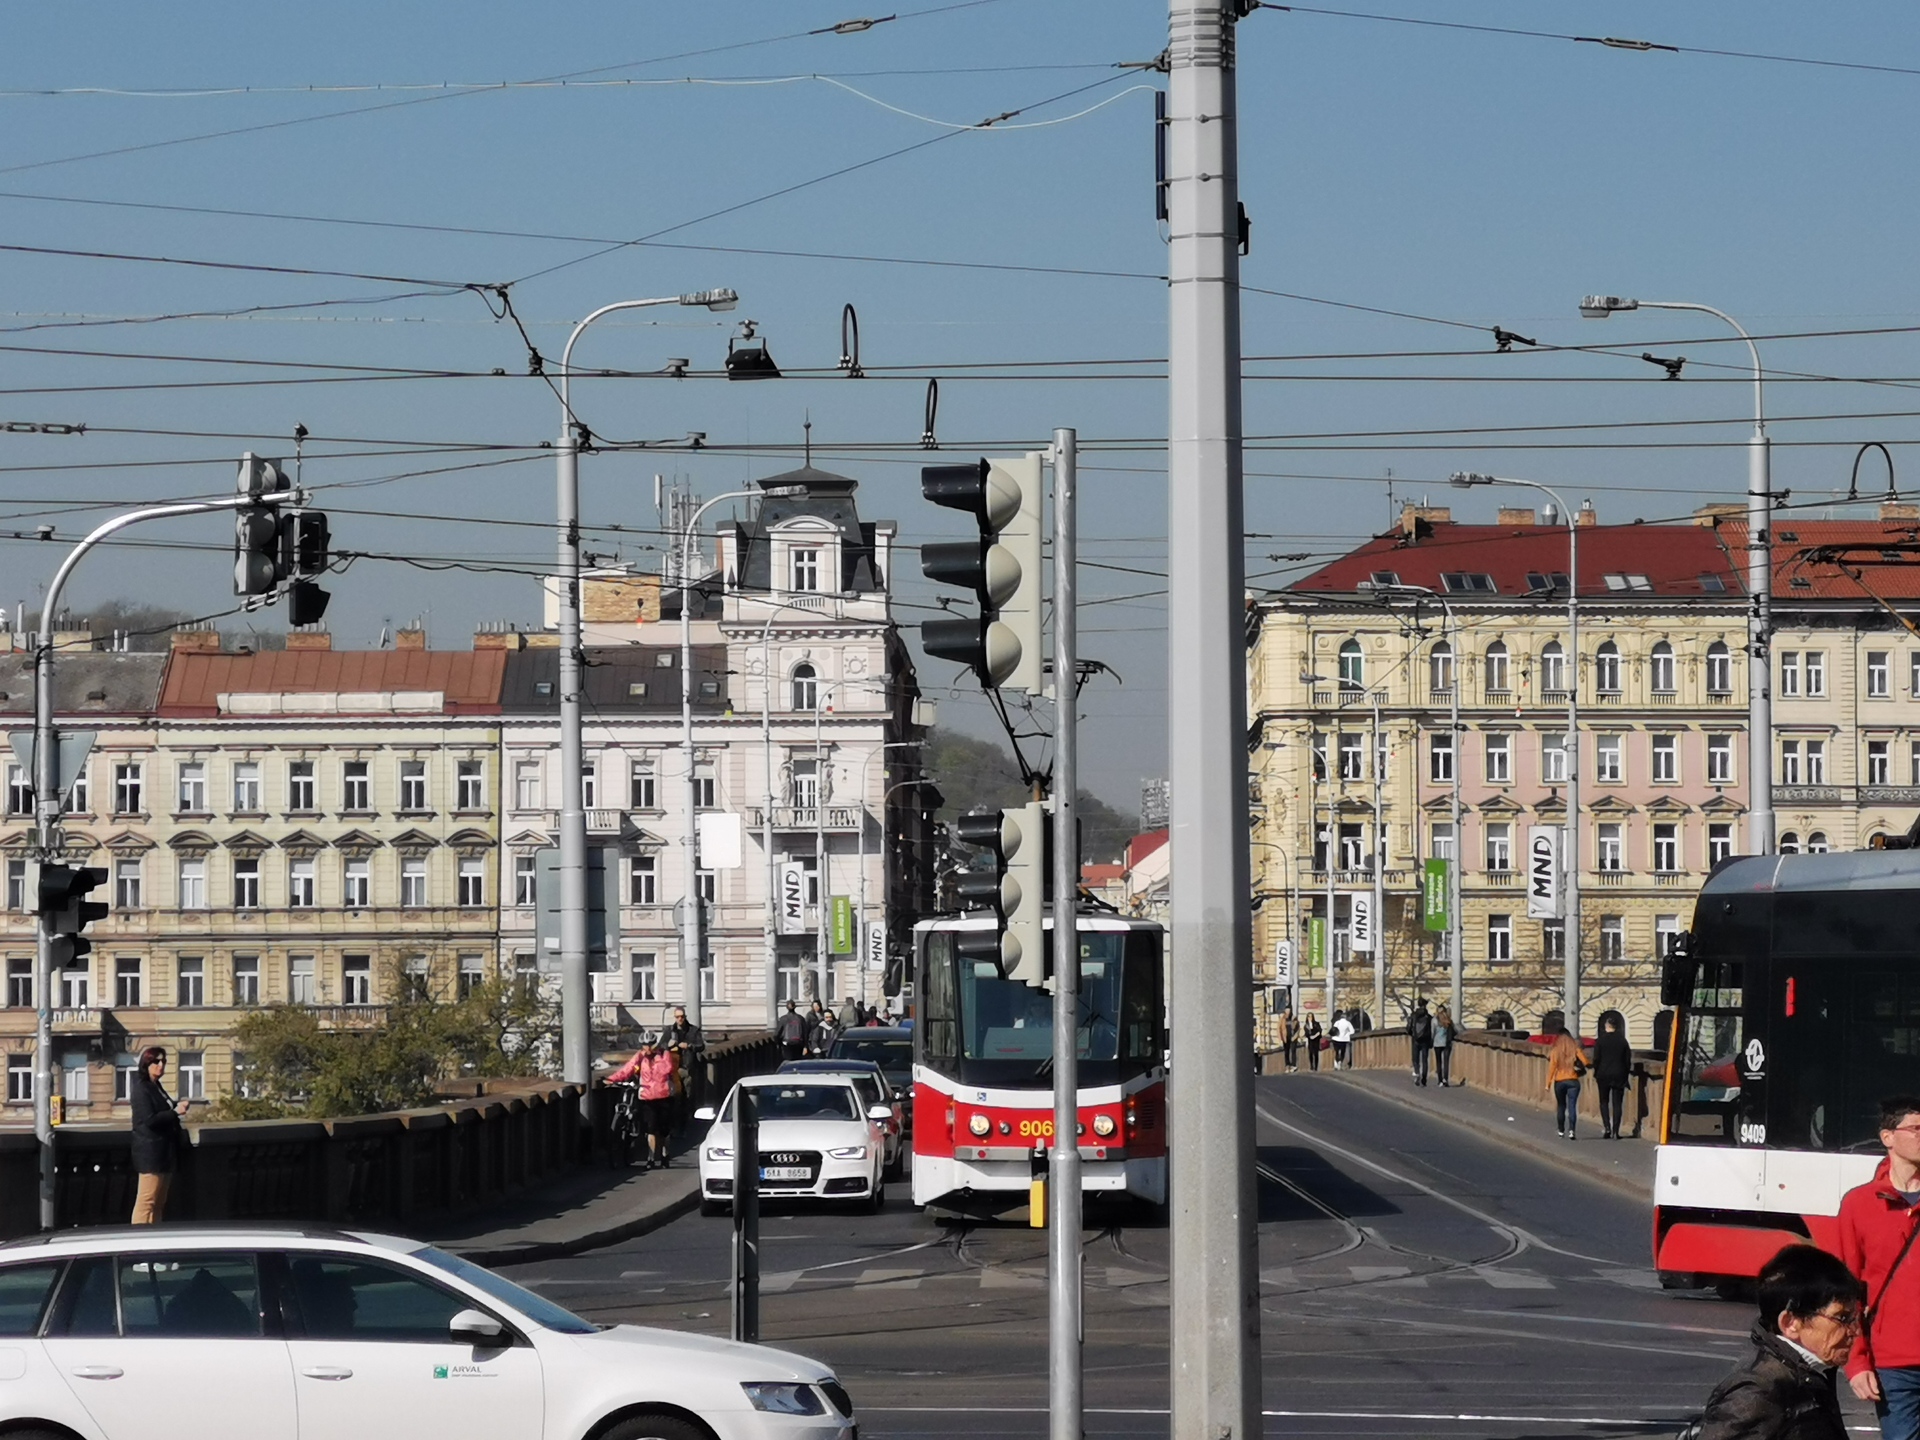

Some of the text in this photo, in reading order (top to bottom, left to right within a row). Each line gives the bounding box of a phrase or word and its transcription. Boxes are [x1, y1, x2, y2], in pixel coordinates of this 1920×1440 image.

[1533, 835, 1553, 899] MND
[785, 870, 801, 919] MND
[1356, 899, 1368, 941] MND
[871, 928, 883, 962] MND
[1279, 945, 1289, 978] MND
[1019, 1120, 1055, 1137] 906
[1740, 1123, 1766, 1144] 9409
[452, 1365, 482, 1373] ARVAL
